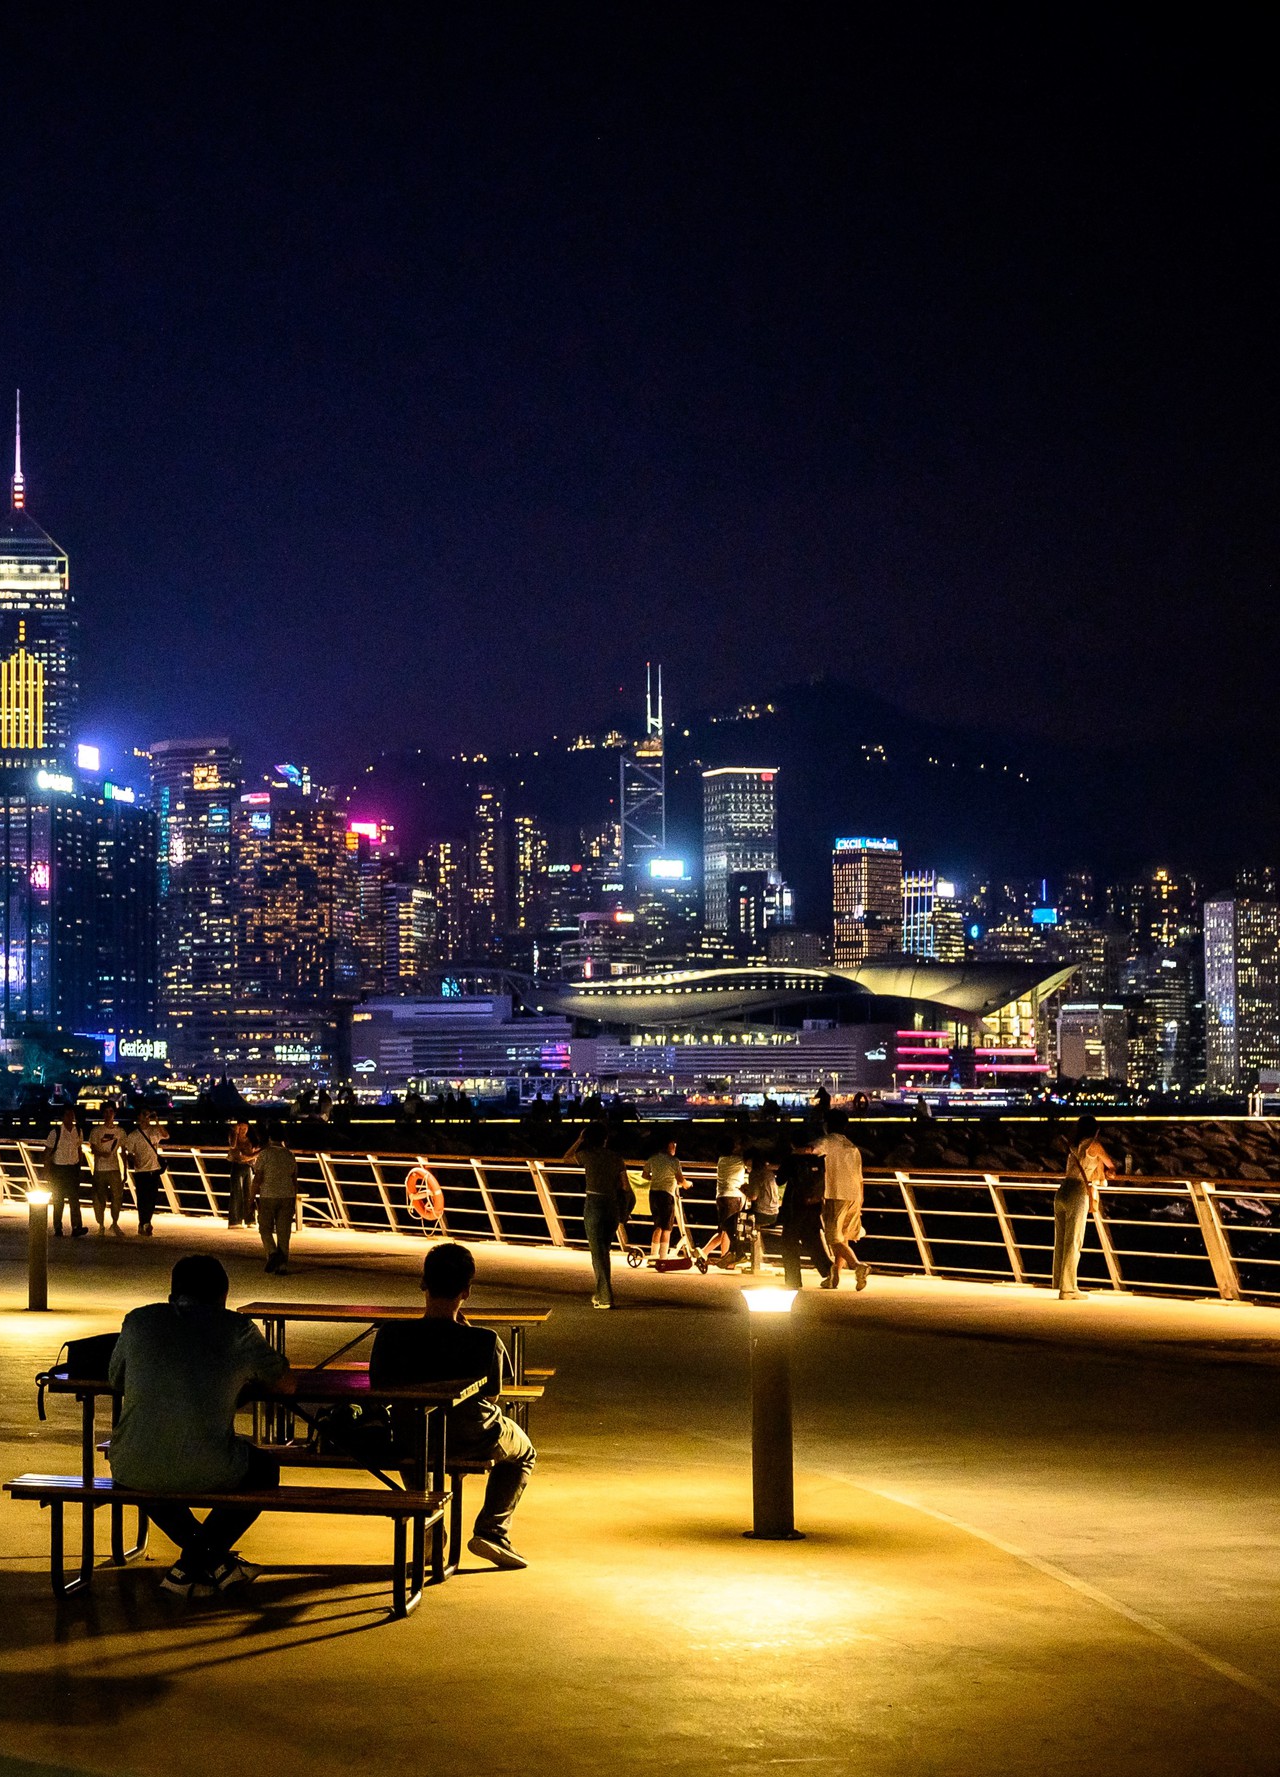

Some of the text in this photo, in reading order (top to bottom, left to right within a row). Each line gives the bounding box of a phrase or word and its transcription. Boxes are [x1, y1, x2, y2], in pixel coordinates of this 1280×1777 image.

[548, 864, 571, 873] LIPPO
[602, 884, 624, 892] LIPPO
[119, 1038, 153, 1061] Great Eagle
